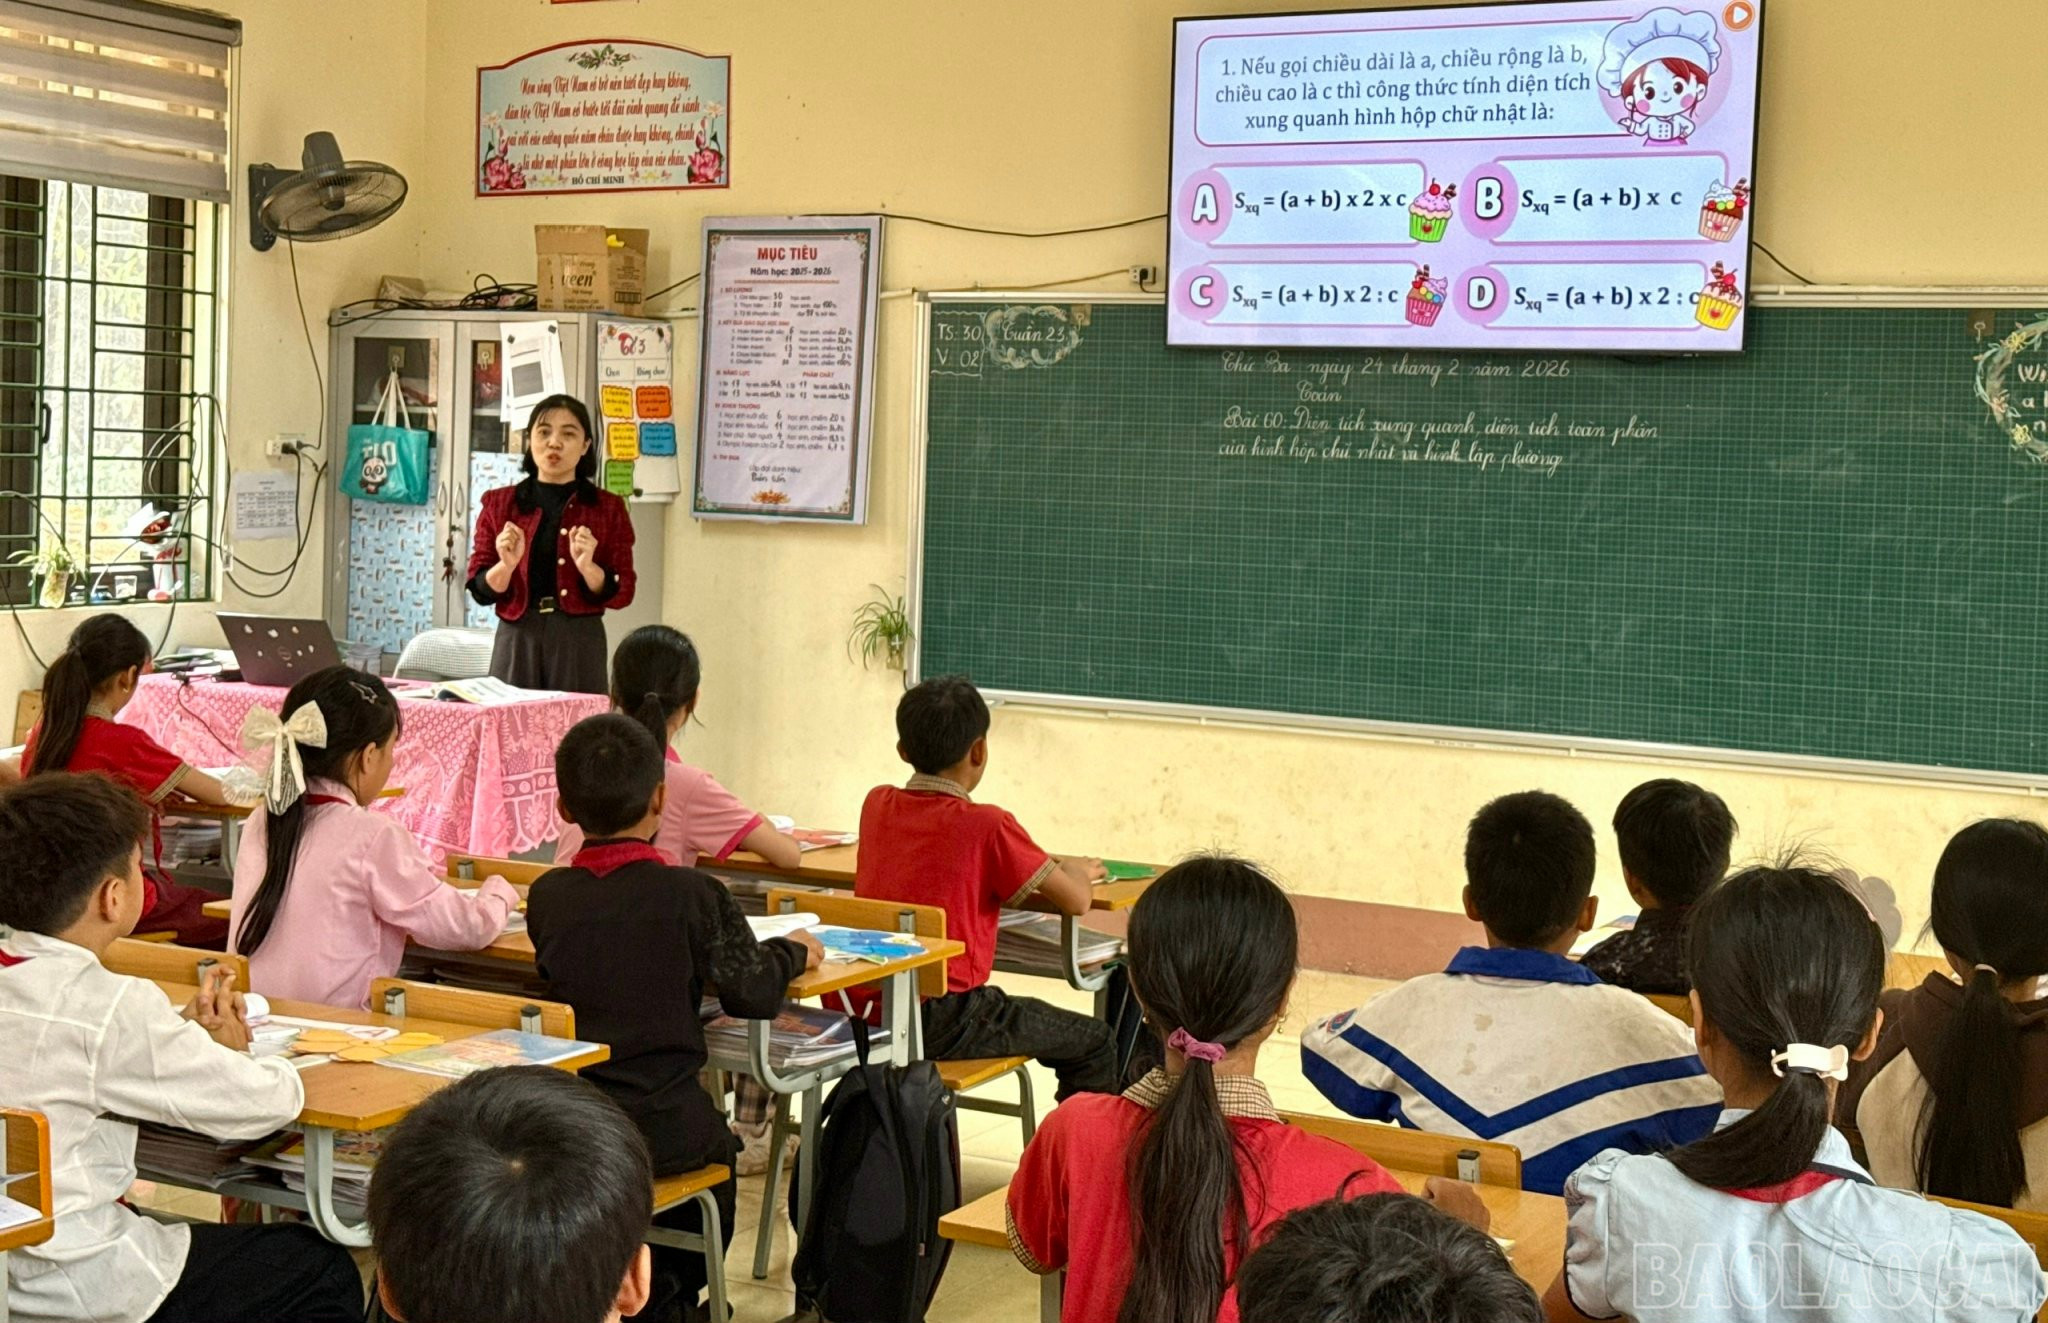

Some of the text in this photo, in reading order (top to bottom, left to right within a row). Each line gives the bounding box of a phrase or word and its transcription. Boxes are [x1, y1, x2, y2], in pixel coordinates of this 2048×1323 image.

[1222, 44, 1588, 77] 1. Nếu gọi chiều dài là a, chiều rộng là b,
[1215, 72, 1590, 103] chiều cao là c thì công thức tính diện tích
[1245, 102, 1554, 132] xung quanh hình hộp chữ nhật là:
[585, 174, 600, 185] CHÍ
[602, 176, 624, 184] MINH
[1191, 183, 1219, 224] A
[1263, 196, 1274, 205] =
[1280, 190, 1298, 212] (a
[1304, 196, 1315, 206] +
[1321, 190, 1341, 212] b)
[1346, 194, 1358, 207] x
[1363, 190, 1374, 207] 2
[1379, 193, 1391, 206] x
[1396, 193, 1407, 207] c
[1475, 176, 1503, 220] B
[1553, 194, 1566, 204] =
[1573, 188, 1593, 211] (a
[1599, 192, 1612, 205] +
[1619, 187, 1640, 210] b)
[1646, 192, 1660, 205] x
[1671, 191, 1682, 205] c
[757, 244, 818, 263] MỤC TIÊU
[750, 267, 769, 276] Năm
[771, 267, 788, 277] học:
[813, 267, 832, 276] 2026
[1188, 274, 1214, 308] C
[1261, 290, 1272, 299] =
[1278, 284, 1296, 306] (a
[1302, 290, 1313, 301] +
[1319, 284, 1338, 306] b)
[1343, 289, 1355, 302] x
[1360, 285, 1371, 302] 2
[1388, 289, 1399, 302] c
[1467, 275, 1497, 311] D
[1547, 292, 1559, 302] =
[1566, 286, 1585, 309] (a
[1592, 291, 1604, 304] +
[1611, 286, 1633, 309] b)
[1638, 291, 1653, 305] x
[1657, 287, 1670, 305] 2
[1688, 291, 1700, 305] c
[1001, 320, 1041, 342] Tuần
[960, 351, 979, 368] 02
[1221, 351, 1571, 388] Thứ Ba ngày 24 tháng 2 năm 2026
[1296, 379, 1342, 402] Toán
